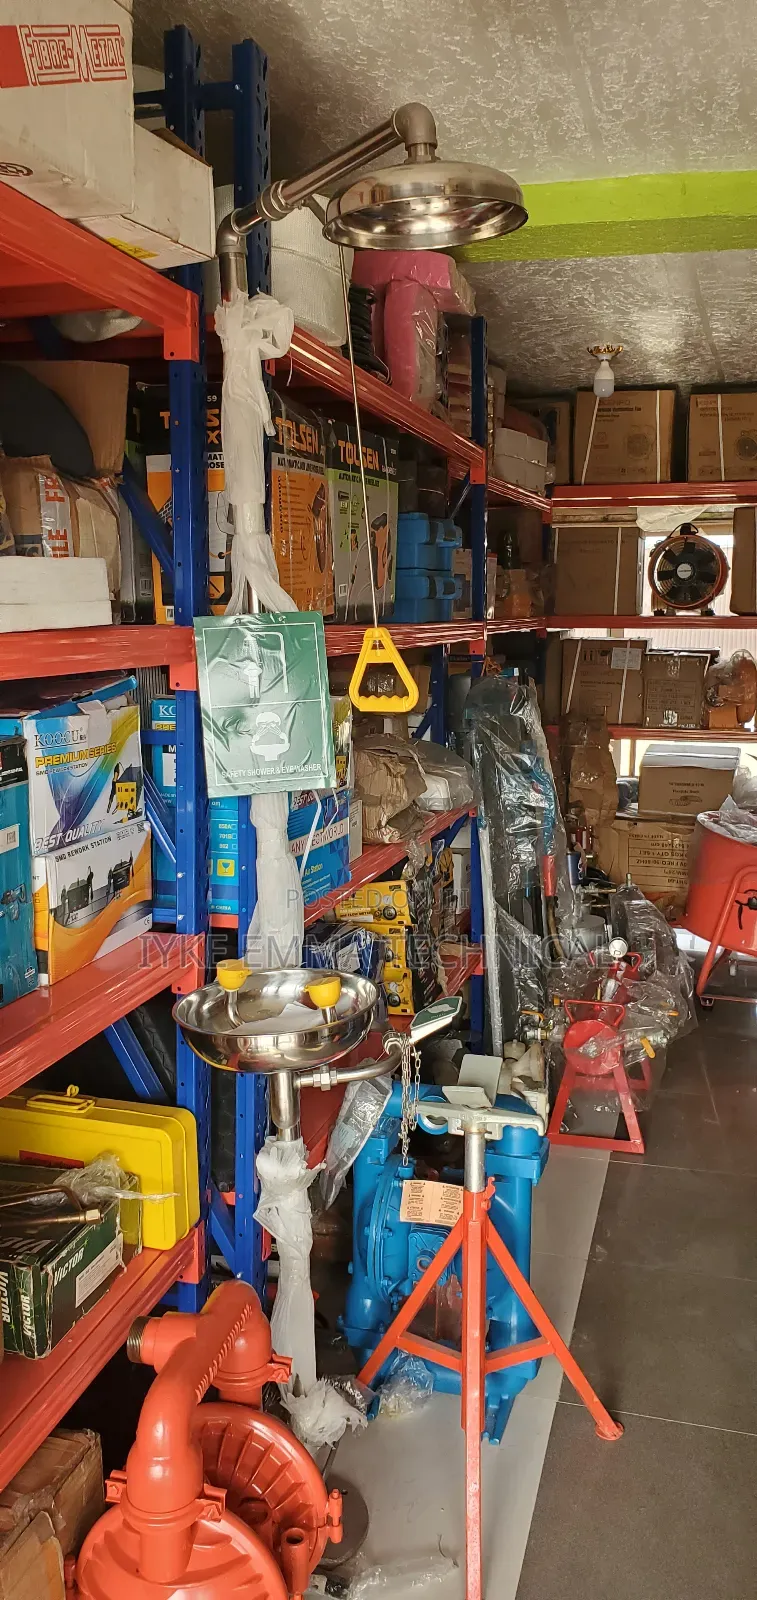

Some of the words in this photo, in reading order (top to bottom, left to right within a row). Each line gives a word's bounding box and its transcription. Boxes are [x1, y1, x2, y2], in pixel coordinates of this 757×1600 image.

[275, 416, 319, 454] TOLSEN
[338, 440, 380, 471] TOLSEN
[35, 749, 89, 768] PREMIUM
[89, 743, 117, 759] SERIES
[221, 769, 246, 778] SAFETY
[247, 766, 275, 776] SHOWER
[35, 832, 64, 850] BEST
[65, 819, 106, 843] QUALITY
[55, 854, 67, 862] SMD
[68, 845, 90, 858] REWORK
[91, 836, 112, 849] STATION
[54, 1247, 85, 1287] VICTOR
